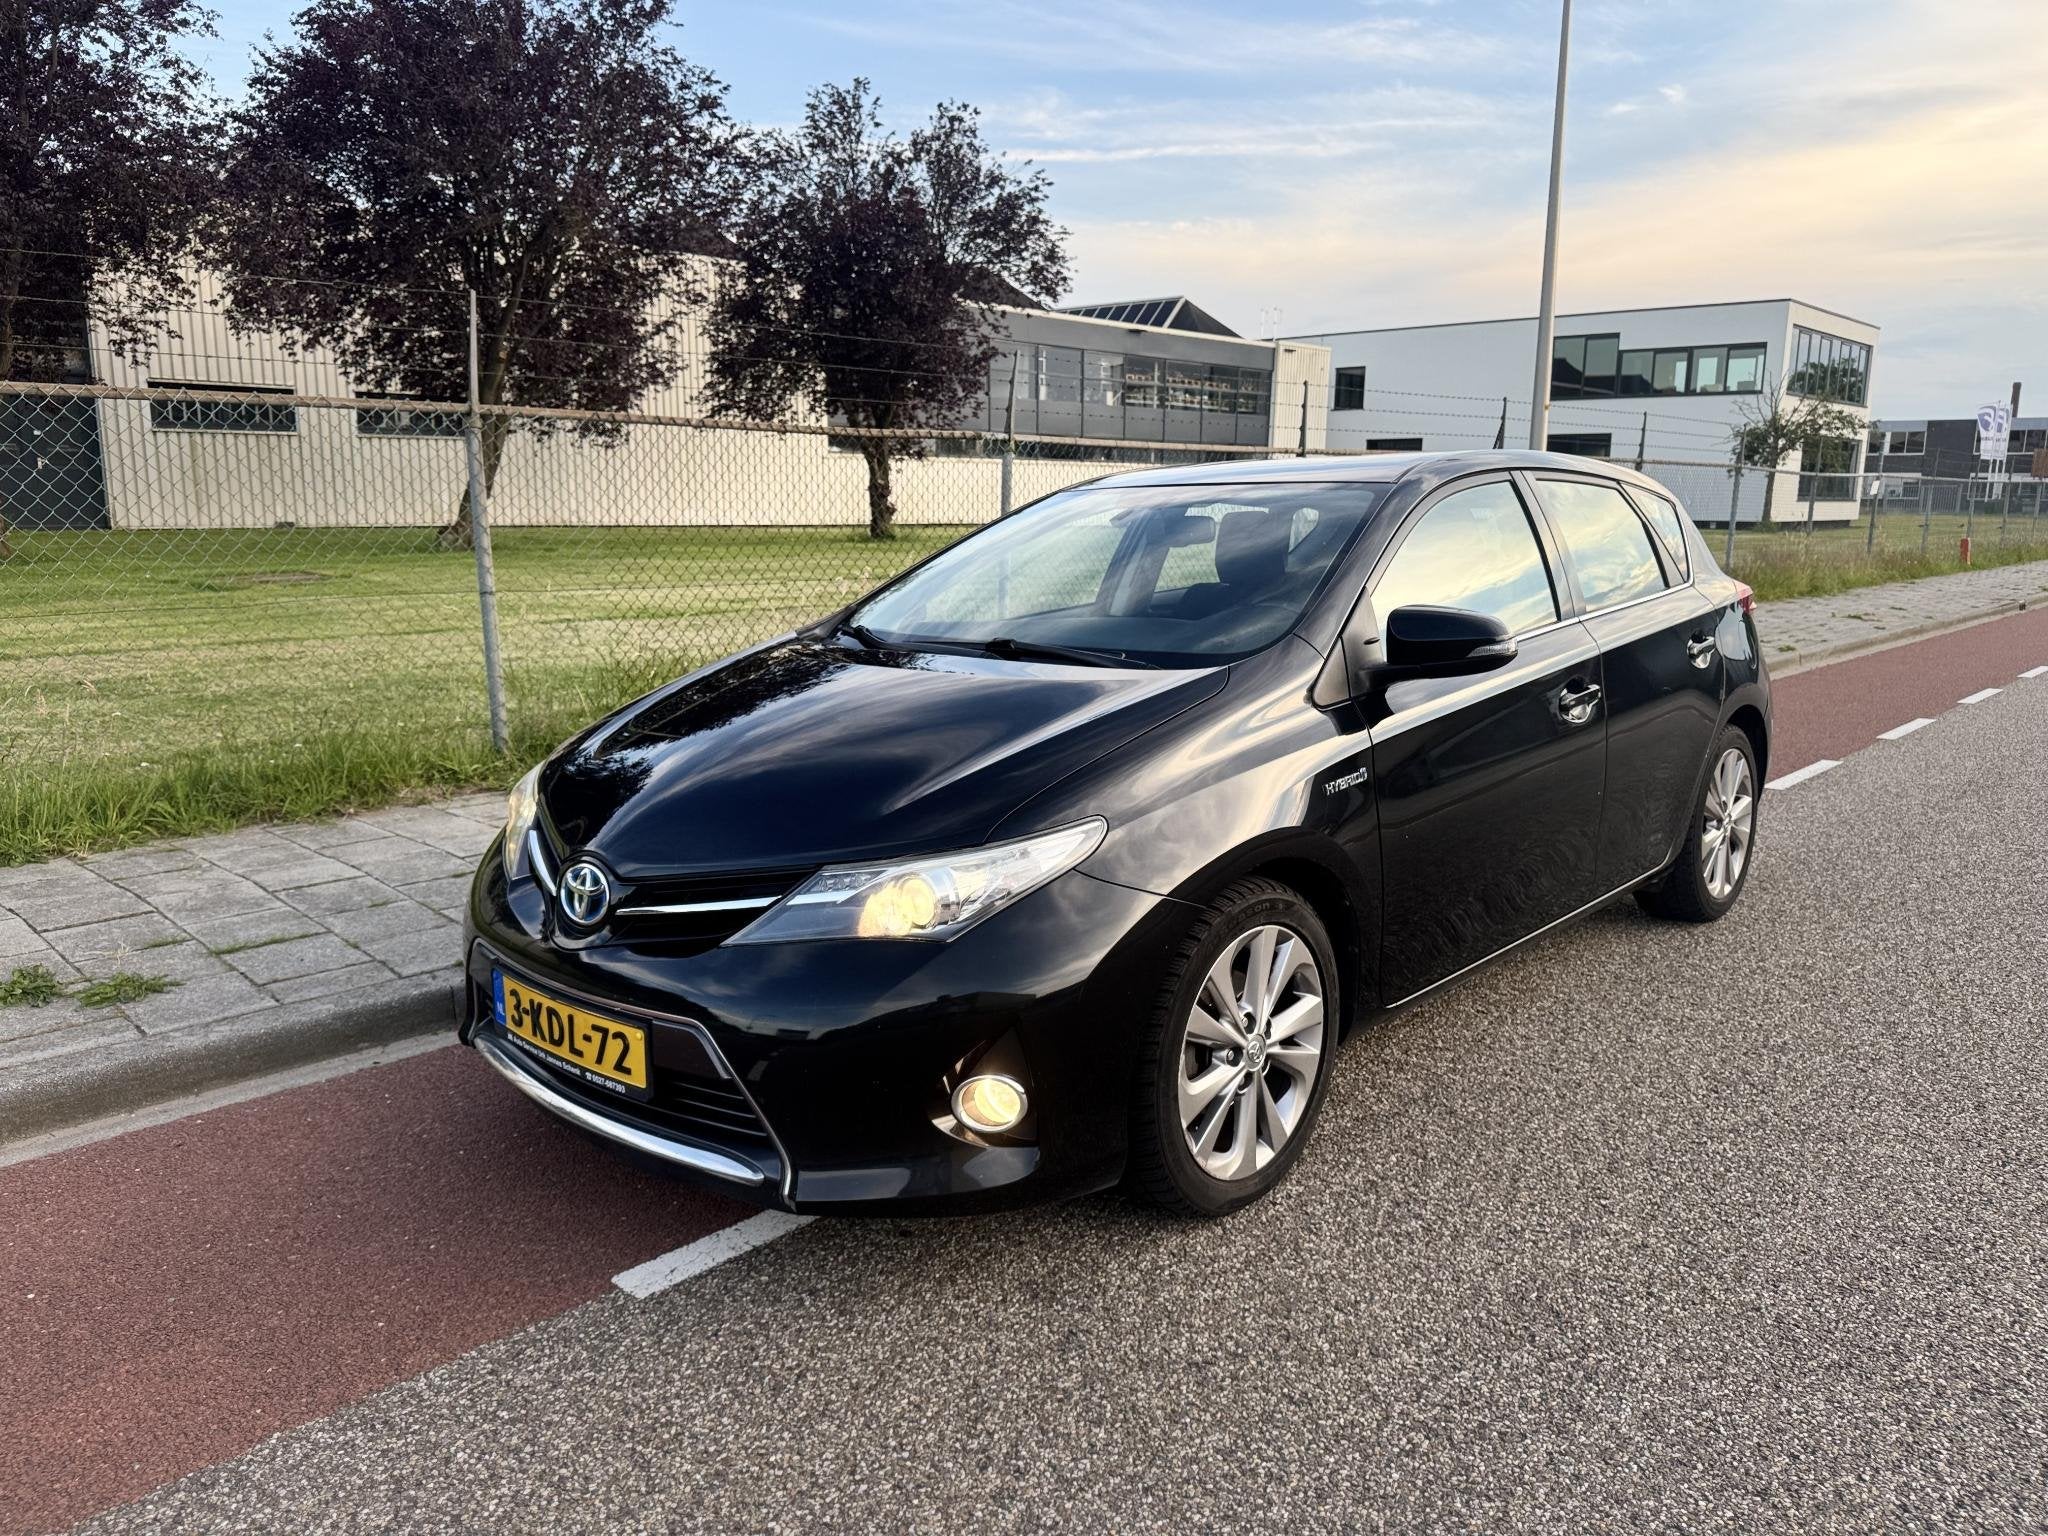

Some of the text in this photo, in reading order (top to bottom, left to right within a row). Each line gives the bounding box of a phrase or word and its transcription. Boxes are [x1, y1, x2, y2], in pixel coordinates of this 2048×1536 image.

[1324, 770, 1362, 796] HYBRID
[496, 1001, 505, 1016] NL
[509, 988, 632, 1076] 3-KDL-72
